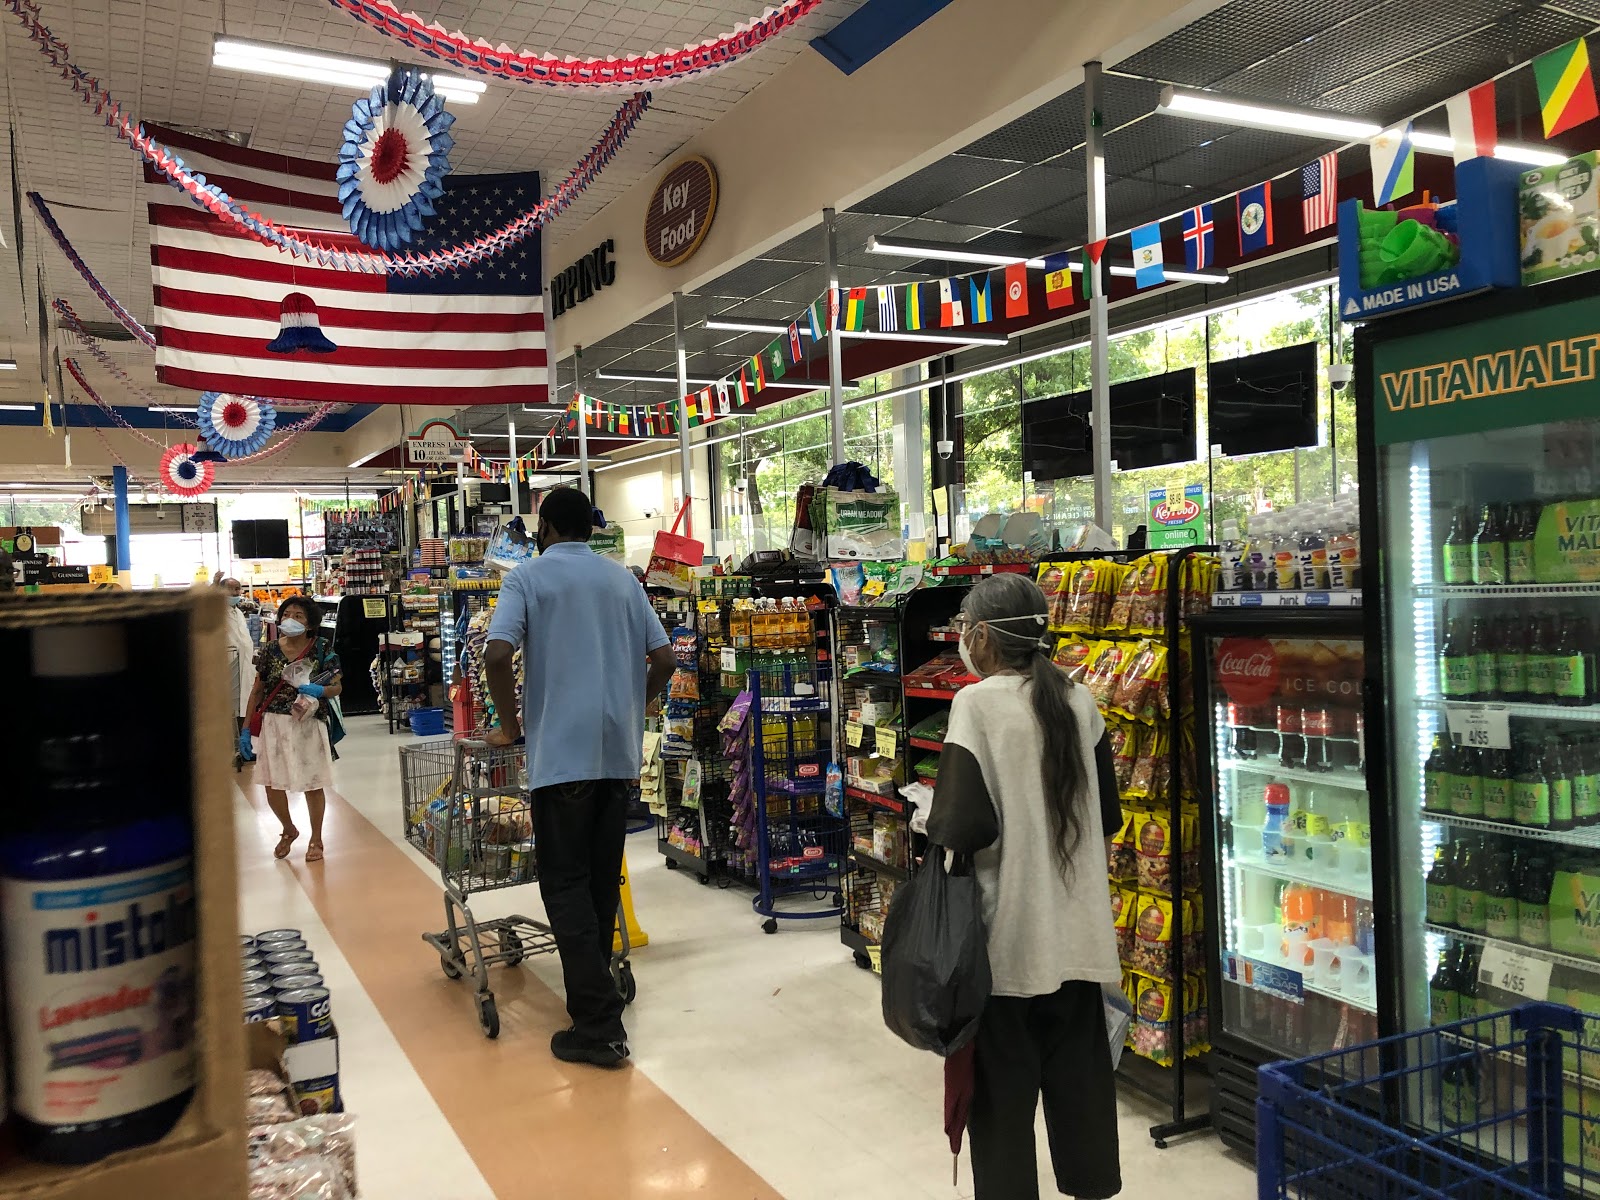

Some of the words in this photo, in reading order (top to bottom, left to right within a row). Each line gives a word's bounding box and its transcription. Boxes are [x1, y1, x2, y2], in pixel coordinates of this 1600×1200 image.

[662, 179, 691, 215] Key
[660, 209, 696, 256] Food
[551, 238, 616, 321] PPING
[1362, 287, 1404, 311] MADE
[1407, 283, 1423, 300] IN
[1426, 274, 1461, 295] USA
[1380, 333, 1600, 412] VITAMALT
[413, 449, 426, 461] 10
[840, 509, 858, 518] URBAN
[859, 509, 884, 519] MEADOW
[1165, 530, 1189, 539] online
[1558, 532, 1600, 552] MAL
[1301, 553, 1315, 587] hint
[1329, 552, 1345, 587] hint
[1217, 596, 1235, 605] hint
[1279, 595, 1299, 605] hint
[1286, 678, 1316, 692] ICE
[1326, 680, 1363, 695] COL
[1469, 730, 1489, 745] 4/$5
[1254, 963, 1289, 981] ZERO
[1253, 971, 1298, 993] SUGAR
[1502, 973, 1525, 992] 4/$5
